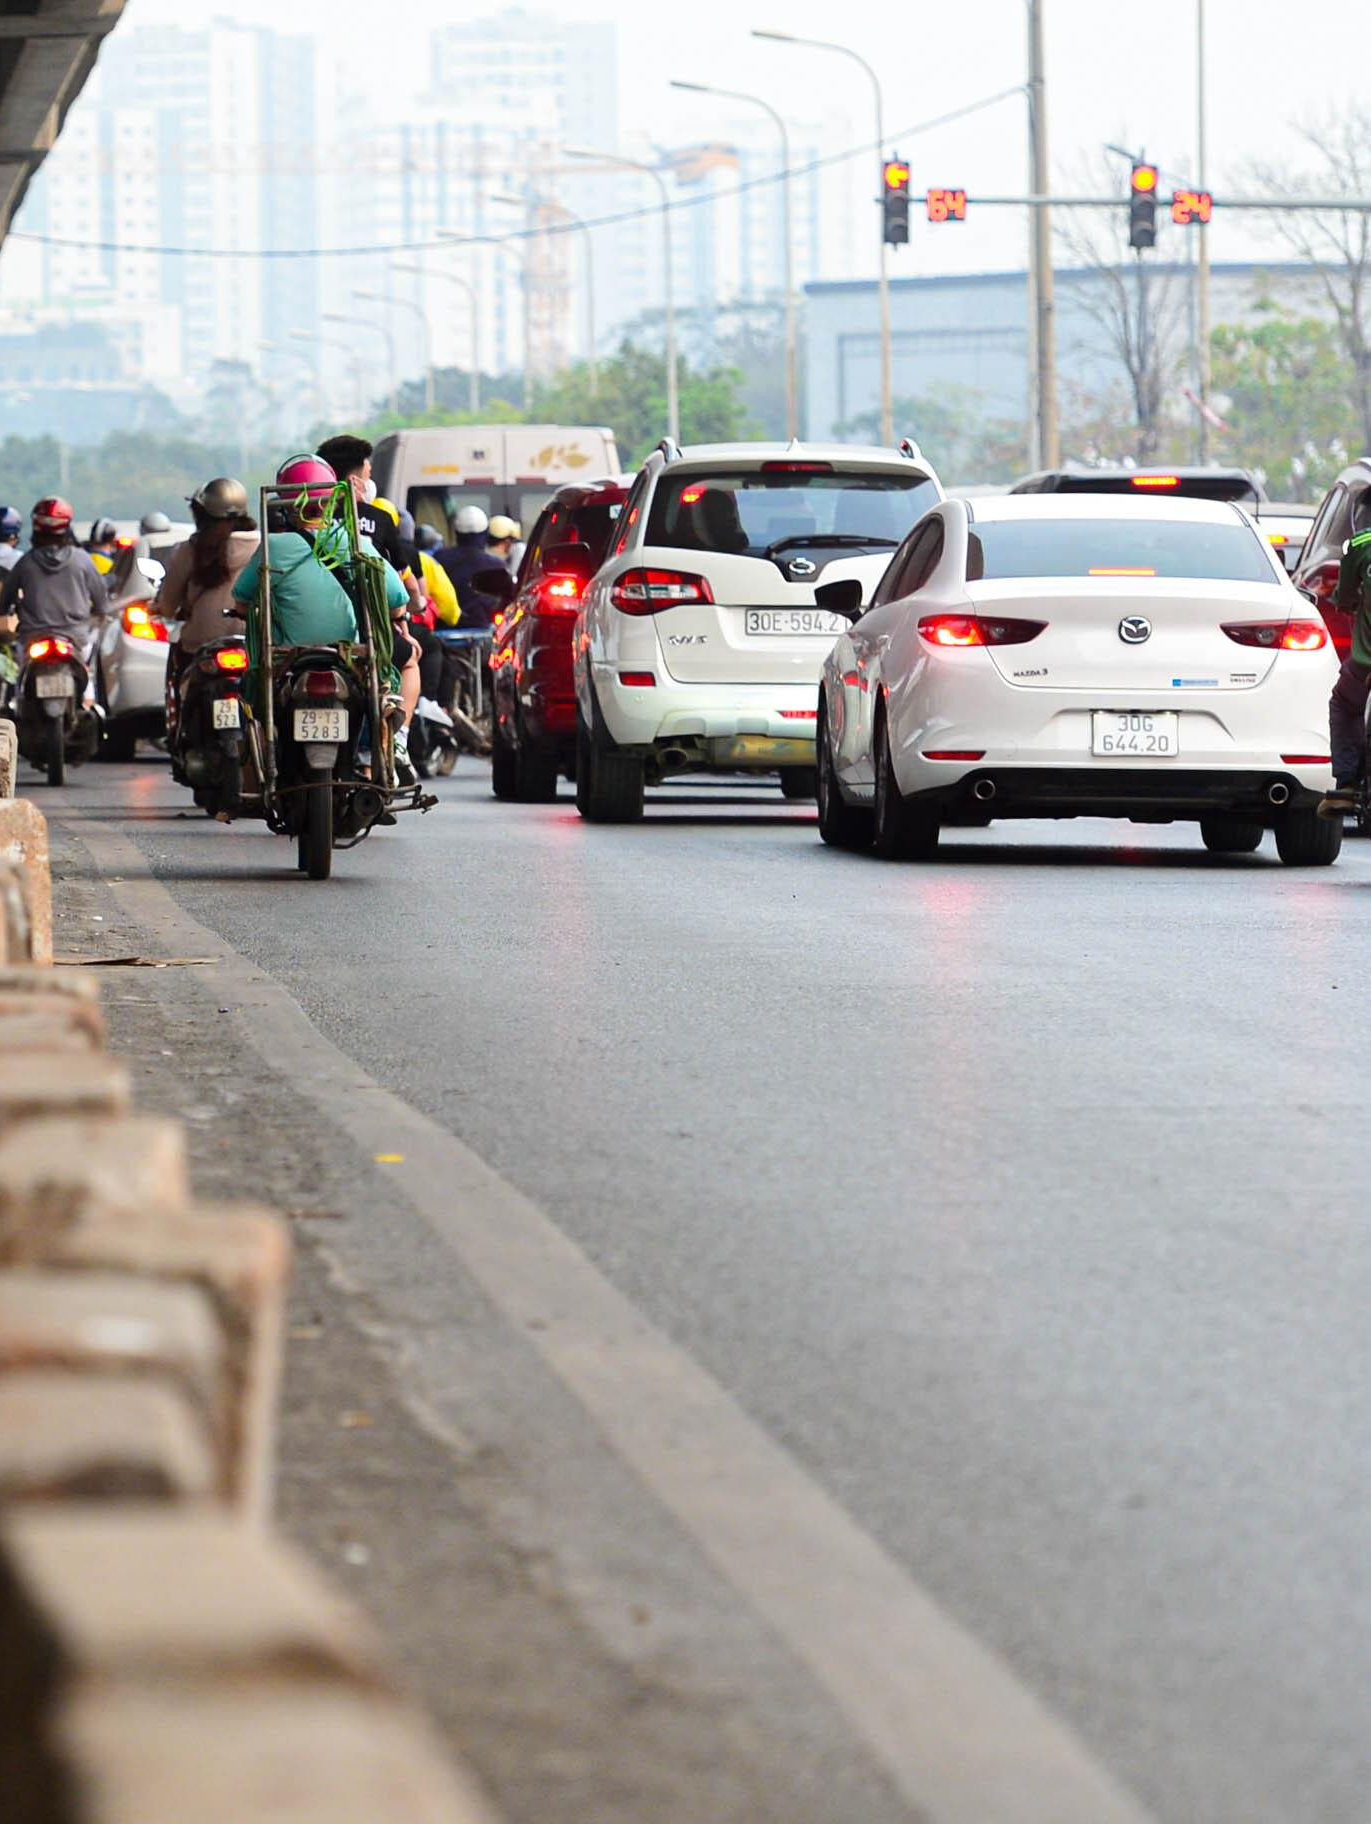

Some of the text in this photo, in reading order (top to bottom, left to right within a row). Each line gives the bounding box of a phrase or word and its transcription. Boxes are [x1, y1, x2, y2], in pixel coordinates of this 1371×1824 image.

[927, 190, 966, 221] 64
[1173, 190, 1212, 224] 24
[749, 612, 848, 631] 30E-594.2
[302, 726, 340, 739] 5283
[1118, 715, 1153, 732] 30G
[1103, 735, 1169, 752] 644.20
